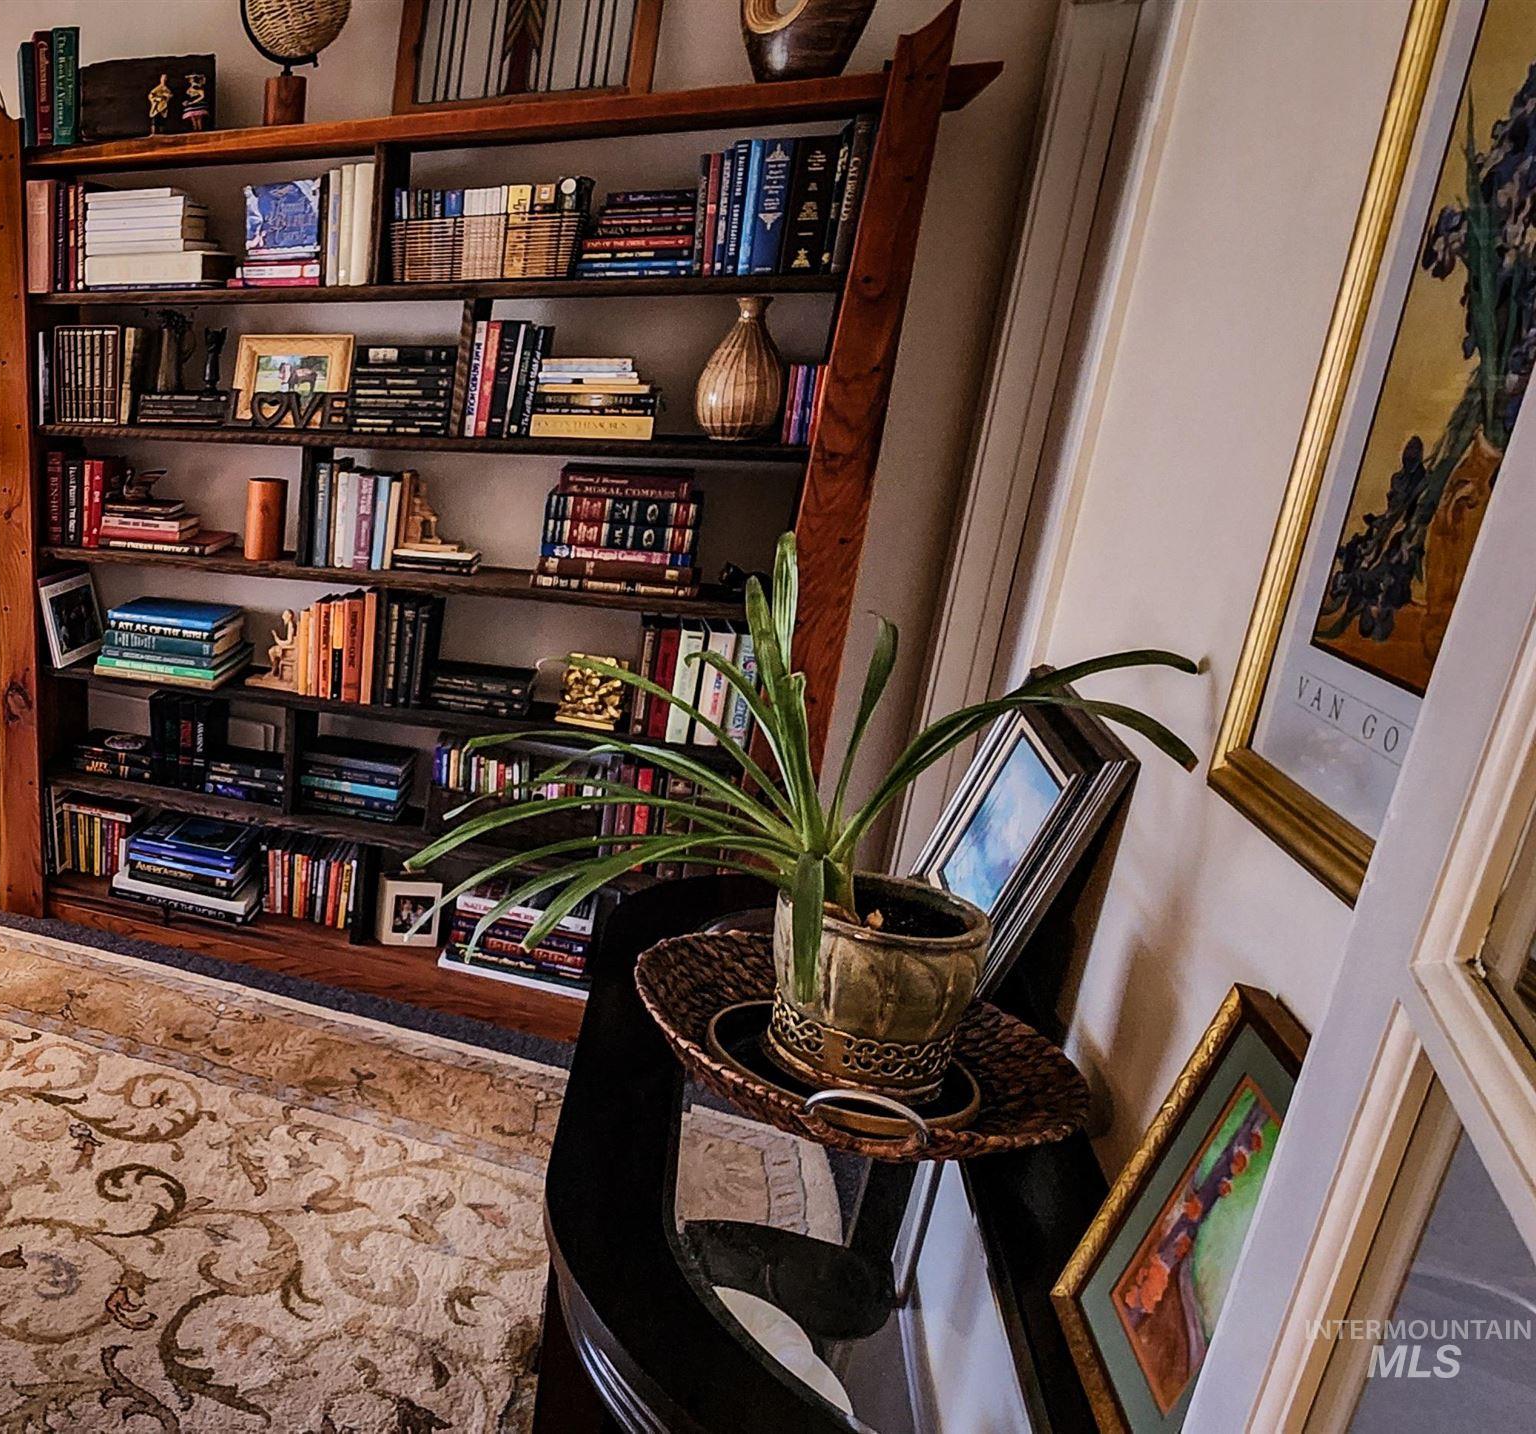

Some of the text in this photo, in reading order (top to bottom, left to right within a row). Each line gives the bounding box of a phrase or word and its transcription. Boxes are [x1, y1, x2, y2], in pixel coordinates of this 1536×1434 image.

[223, 388, 352, 430] LOVE
[584, 486, 624, 497] MORAL
[624, 487, 676, 499] COMPASS
[117, 620, 149, 634] ATLAS
[148, 625, 163, 635] OF
[163, 626, 182, 638] THE
[1297, 675, 1345, 721] VAN
[167, 900, 180, 911] OF
[195, 905, 226, 920] WORLD
